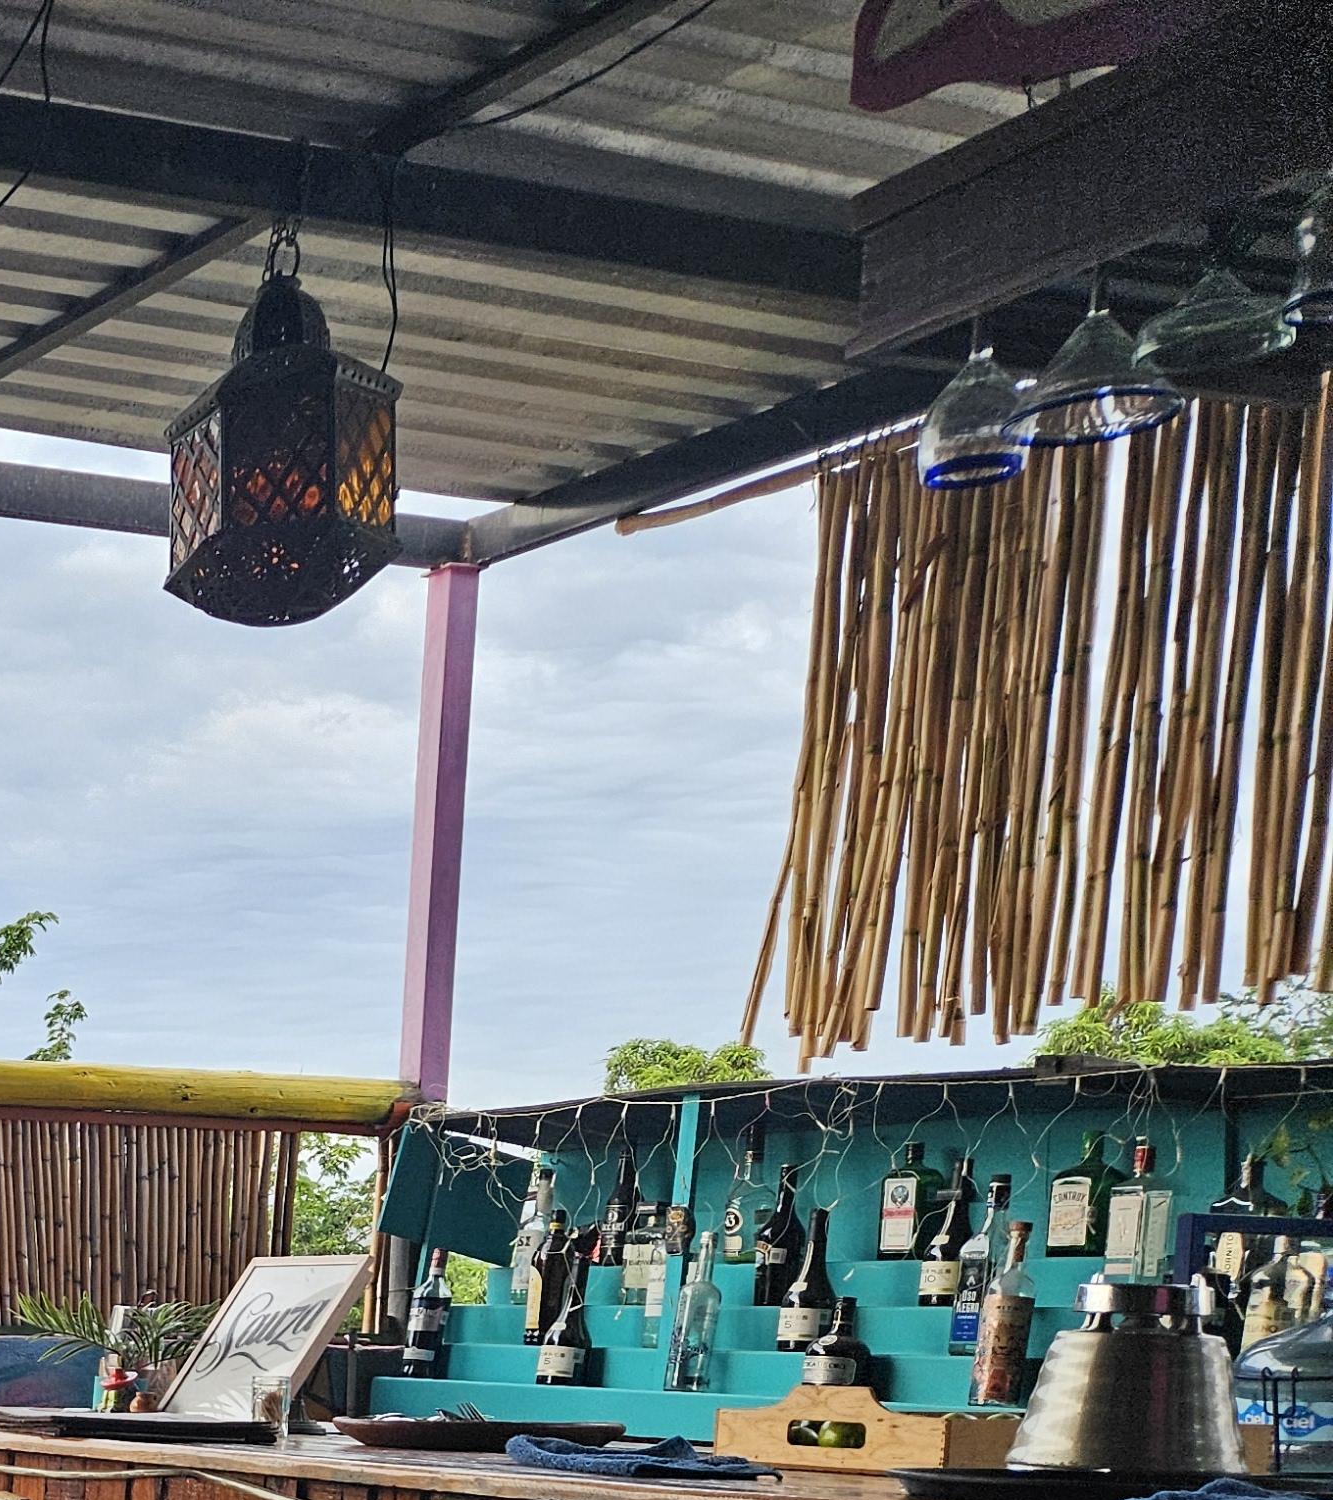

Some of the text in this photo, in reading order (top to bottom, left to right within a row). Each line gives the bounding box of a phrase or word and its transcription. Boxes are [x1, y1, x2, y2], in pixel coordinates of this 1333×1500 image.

[1052, 1190, 1087, 1205] CONTROY
[1224, 1234, 1234, 1273] ORNITO
[924, 1274, 937, 1283] 10
[784, 1320, 792, 1329] 5
[194, 1291, 331, 1381] Sauza
[544, 1357, 551, 1365] 5
[1282, 1414, 1315, 1429] ciel
